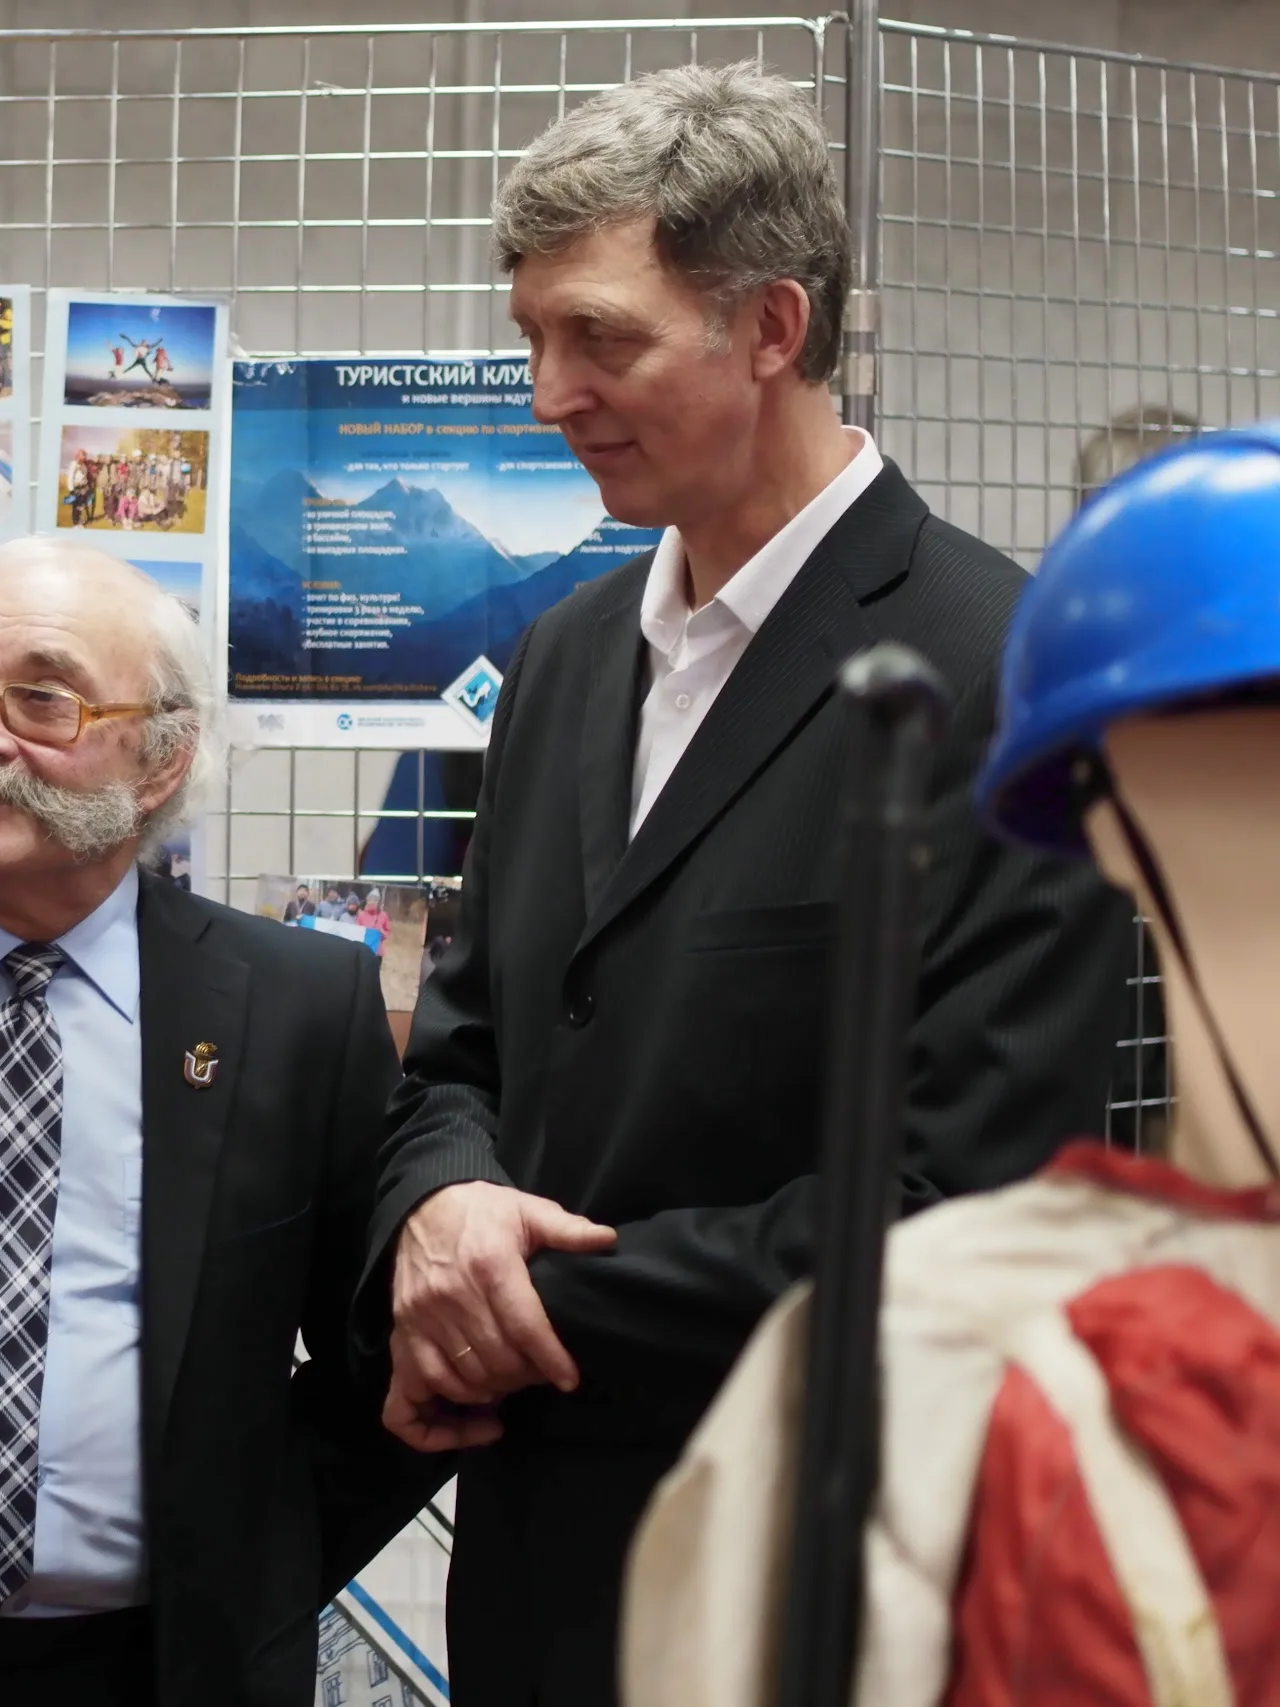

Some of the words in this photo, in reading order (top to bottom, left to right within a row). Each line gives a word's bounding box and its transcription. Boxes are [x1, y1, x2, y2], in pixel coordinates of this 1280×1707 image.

[335, 362, 476, 386] ТУРИСТСКИЙ
[482, 365, 534, 386] КЛУБ
[412, 395, 448, 404] новые
[451, 395, 502, 407] вершины
[338, 422, 381, 435] НОВЫЙ
[384, 424, 424, 435] НАБОР
[437, 426, 479, 437] секцию
[481, 425, 495, 435] по
